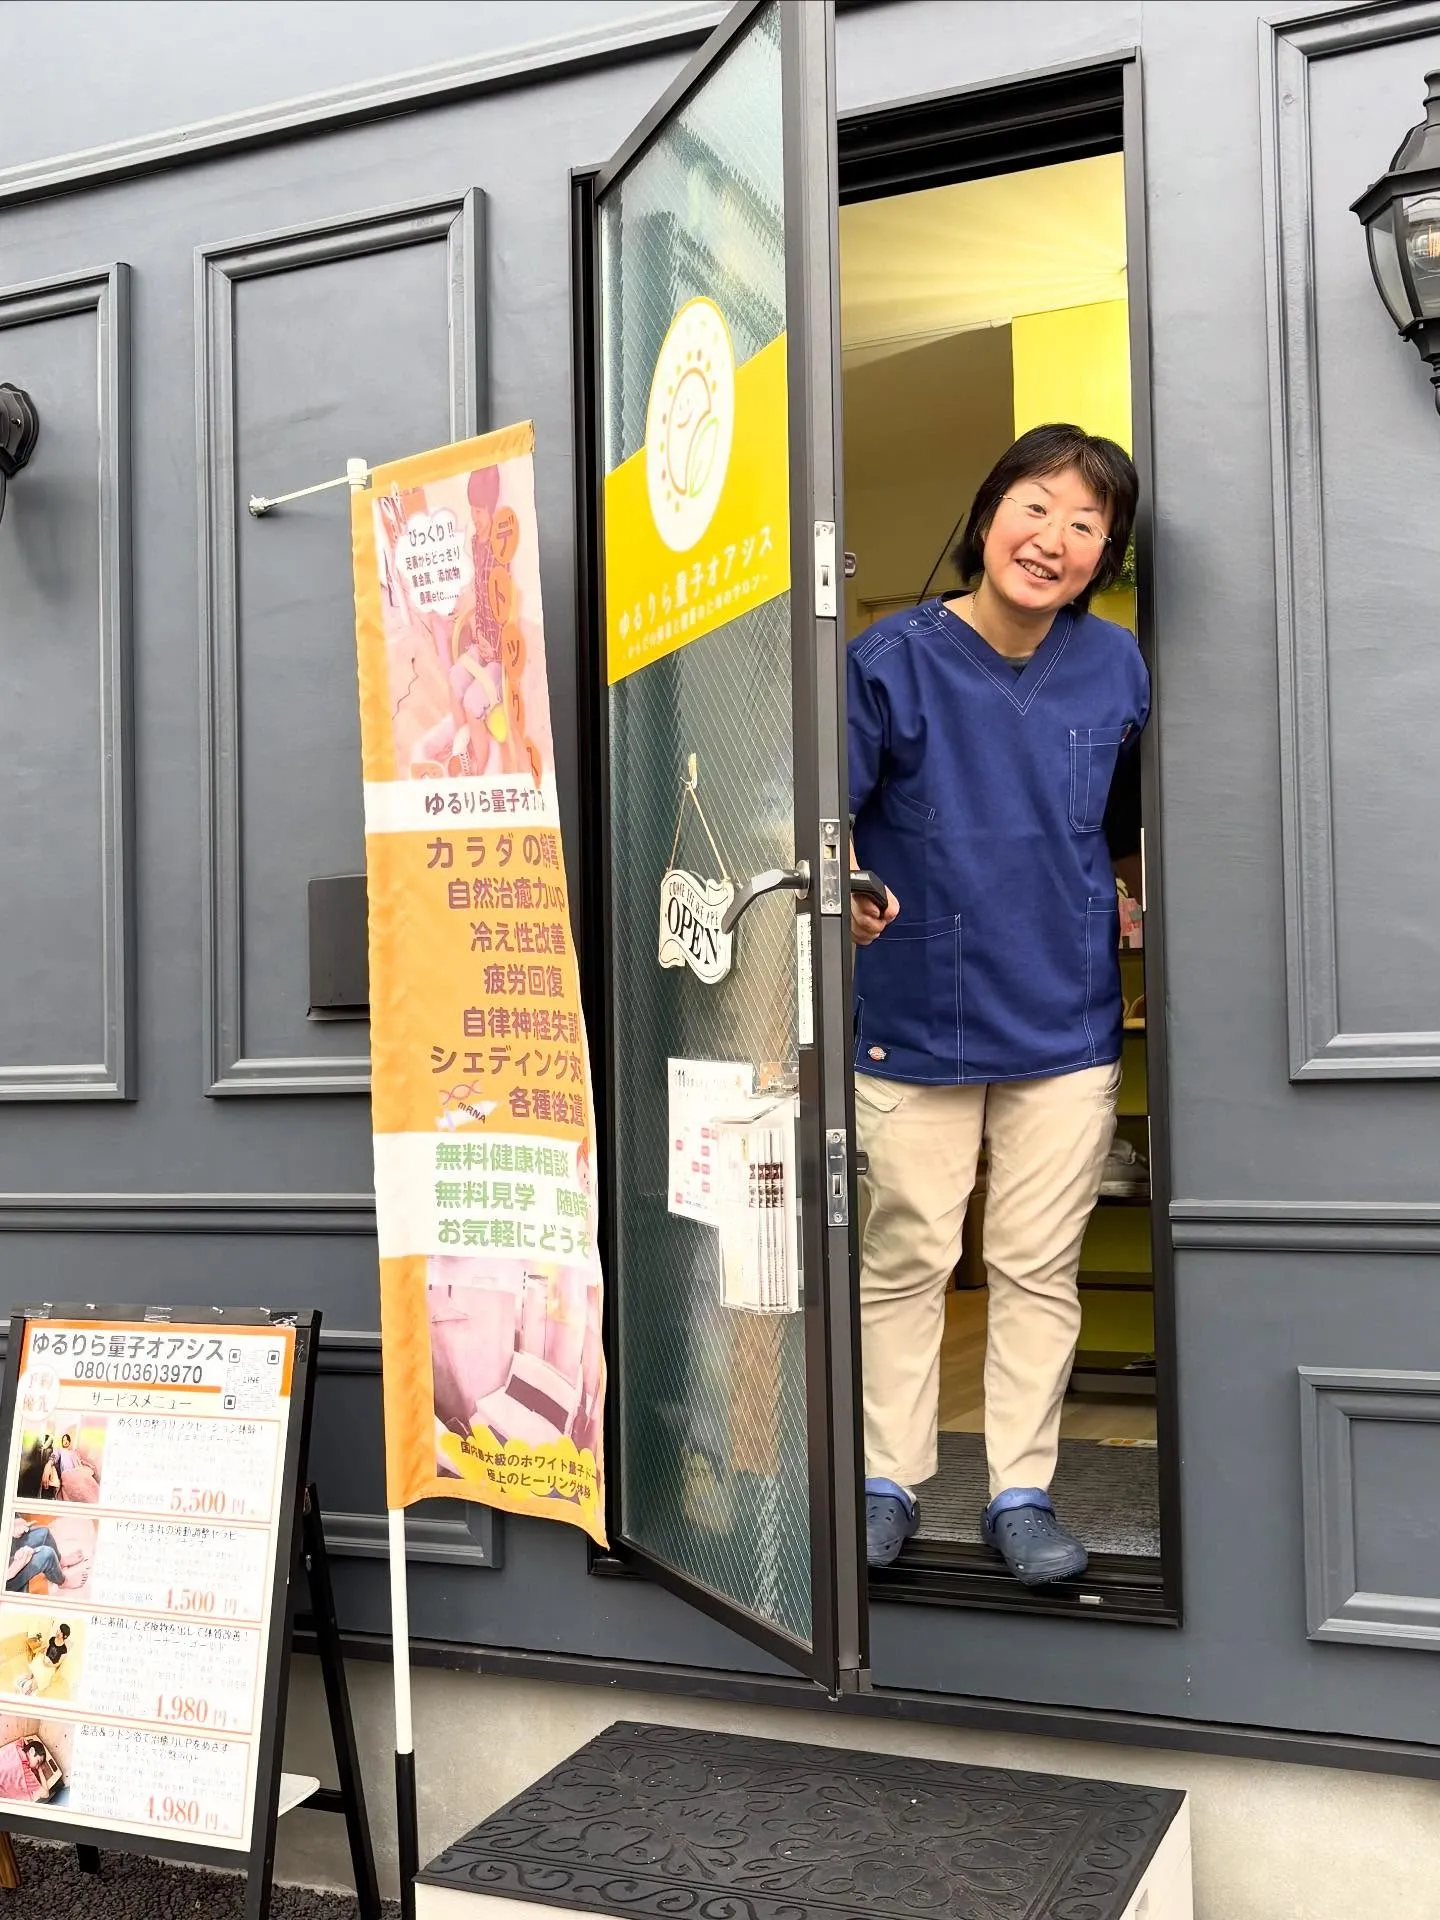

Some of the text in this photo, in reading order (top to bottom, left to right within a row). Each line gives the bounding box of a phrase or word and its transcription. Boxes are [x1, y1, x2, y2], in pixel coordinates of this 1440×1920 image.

[469, 920, 567, 955] 冷え性改善
[667, 896, 720, 965] OPEN
[483, 962, 565, 998] 疲労回復
[457, 1101, 488, 1125] mRNA
[434, 1142, 571, 1179] 無料健康相談
[434, 1180, 536, 1211] 無料見学
[32, 1332, 224, 1361] ゆるりら量子オアシス
[74, 1361, 203, 1385] 080(1036)3970
[91, 1391, 193, 1410] サービスメニュー
